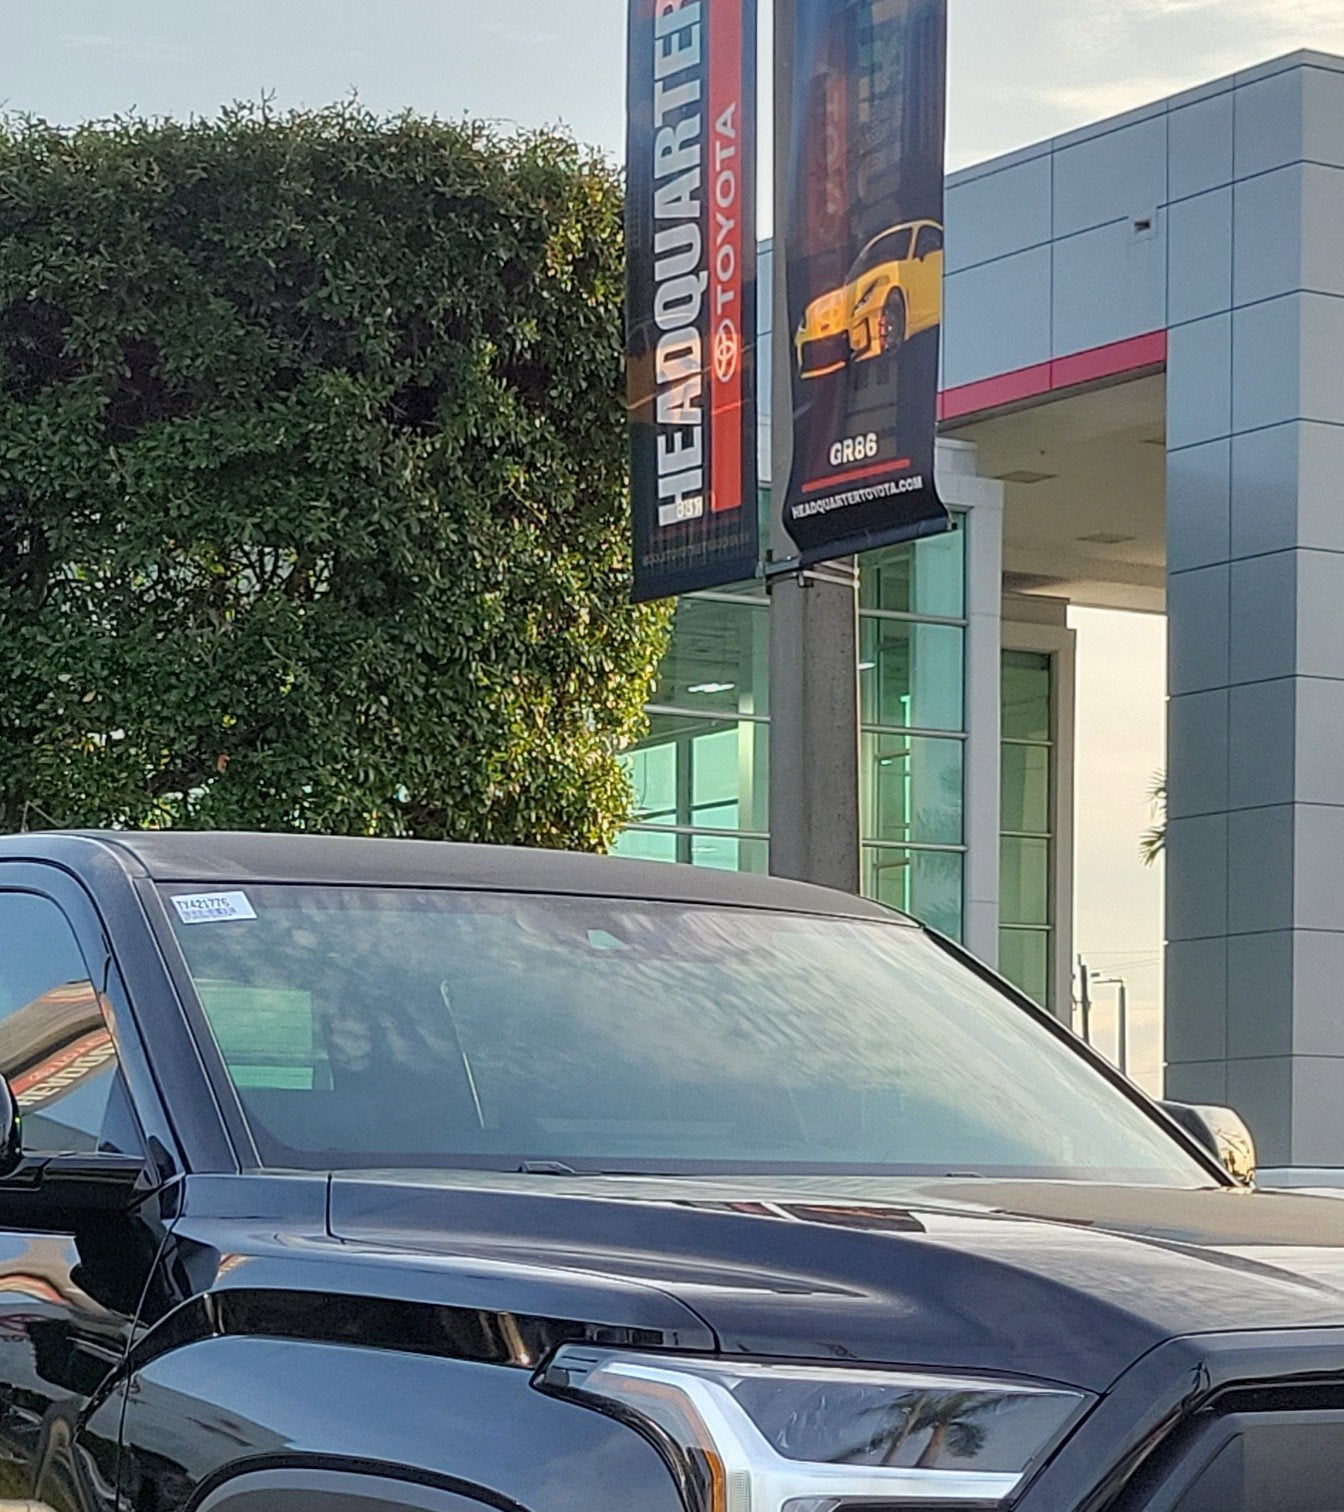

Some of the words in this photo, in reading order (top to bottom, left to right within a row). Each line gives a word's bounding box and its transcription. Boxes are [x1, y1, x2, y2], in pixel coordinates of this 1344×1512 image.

[654, 0, 707, 526] HEADQUARTER
[715, 102, 736, 314] TOYOTA
[791, 475, 924, 519] HEADQUARTERTOYOTA.COM
[829, 432, 878, 466] GR86
